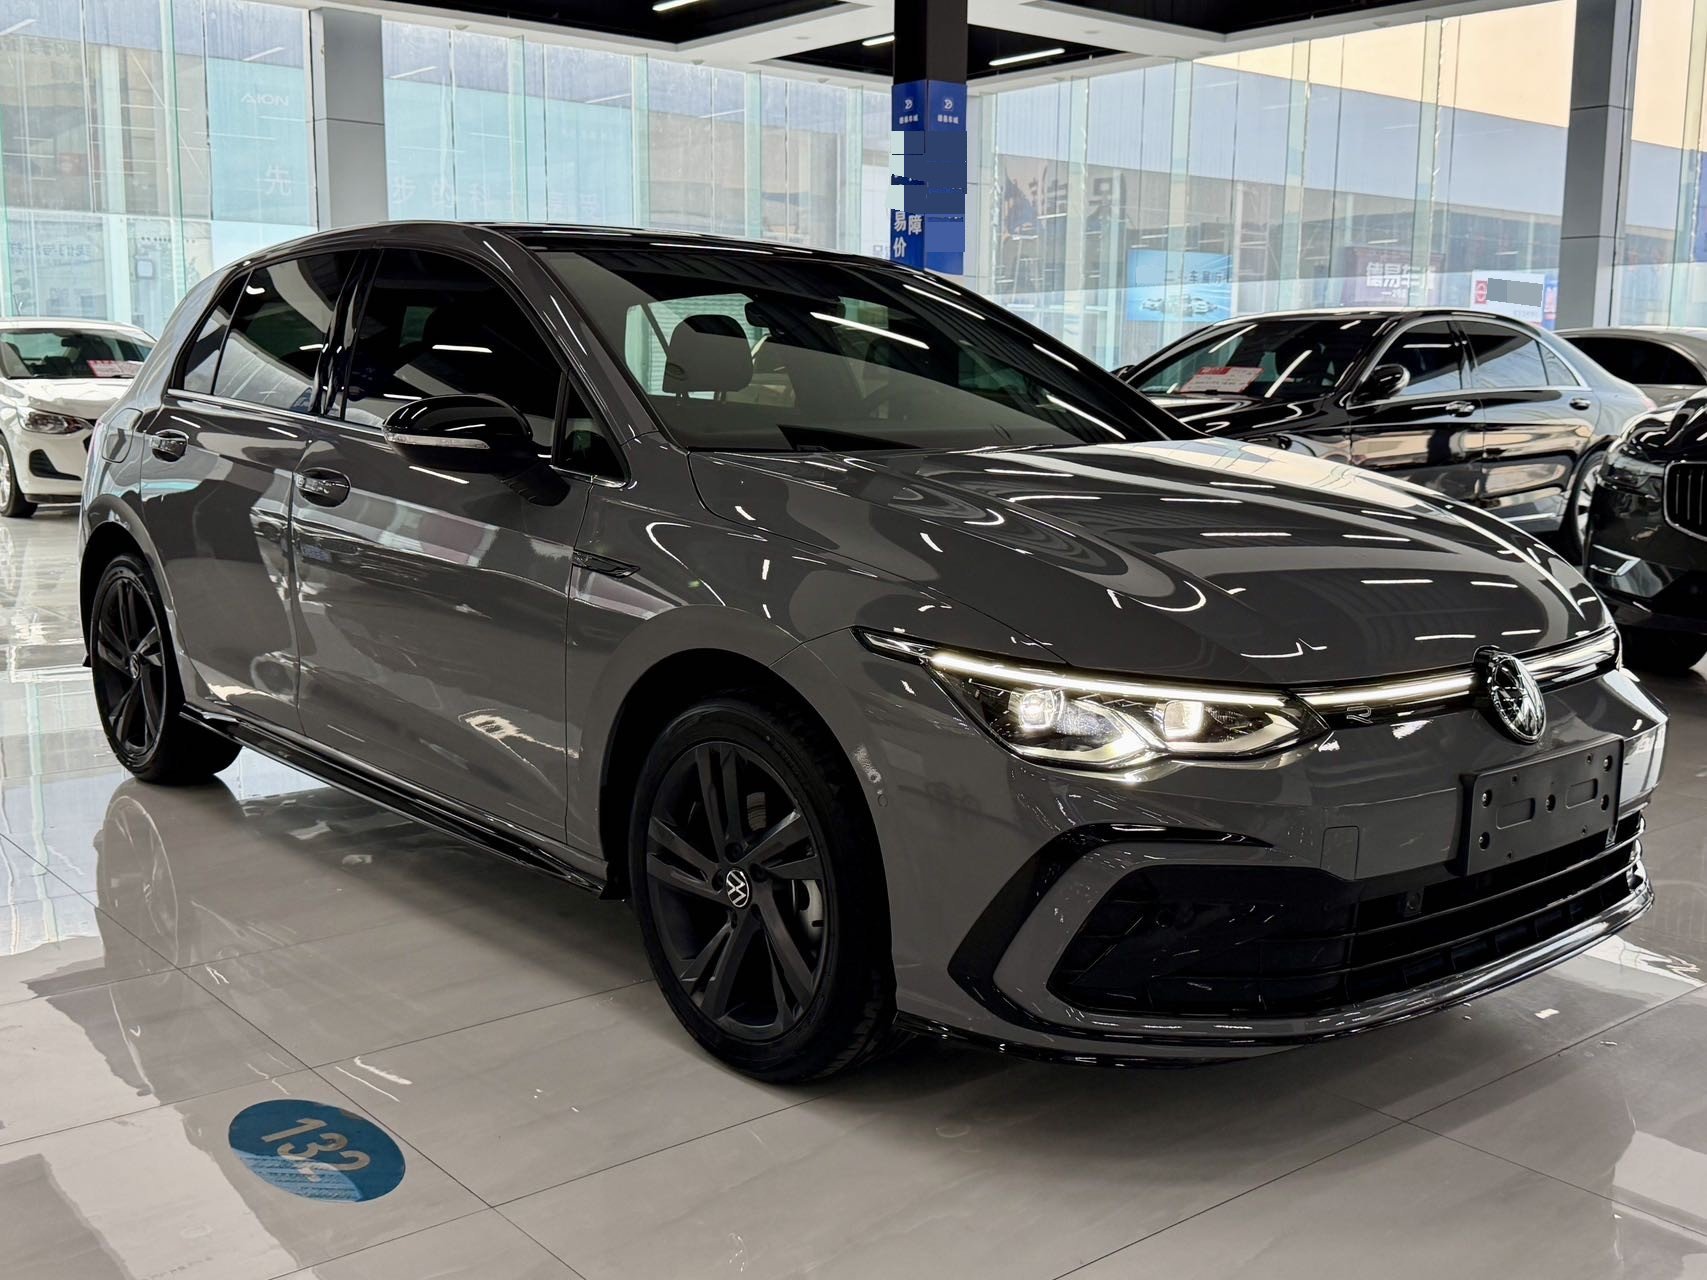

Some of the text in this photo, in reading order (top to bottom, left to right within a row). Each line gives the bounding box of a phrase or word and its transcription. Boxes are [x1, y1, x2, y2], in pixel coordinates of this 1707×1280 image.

[240, 93, 289, 106] AION
[264, 163, 293, 196] 先
[261, 1117, 370, 1182] 132
